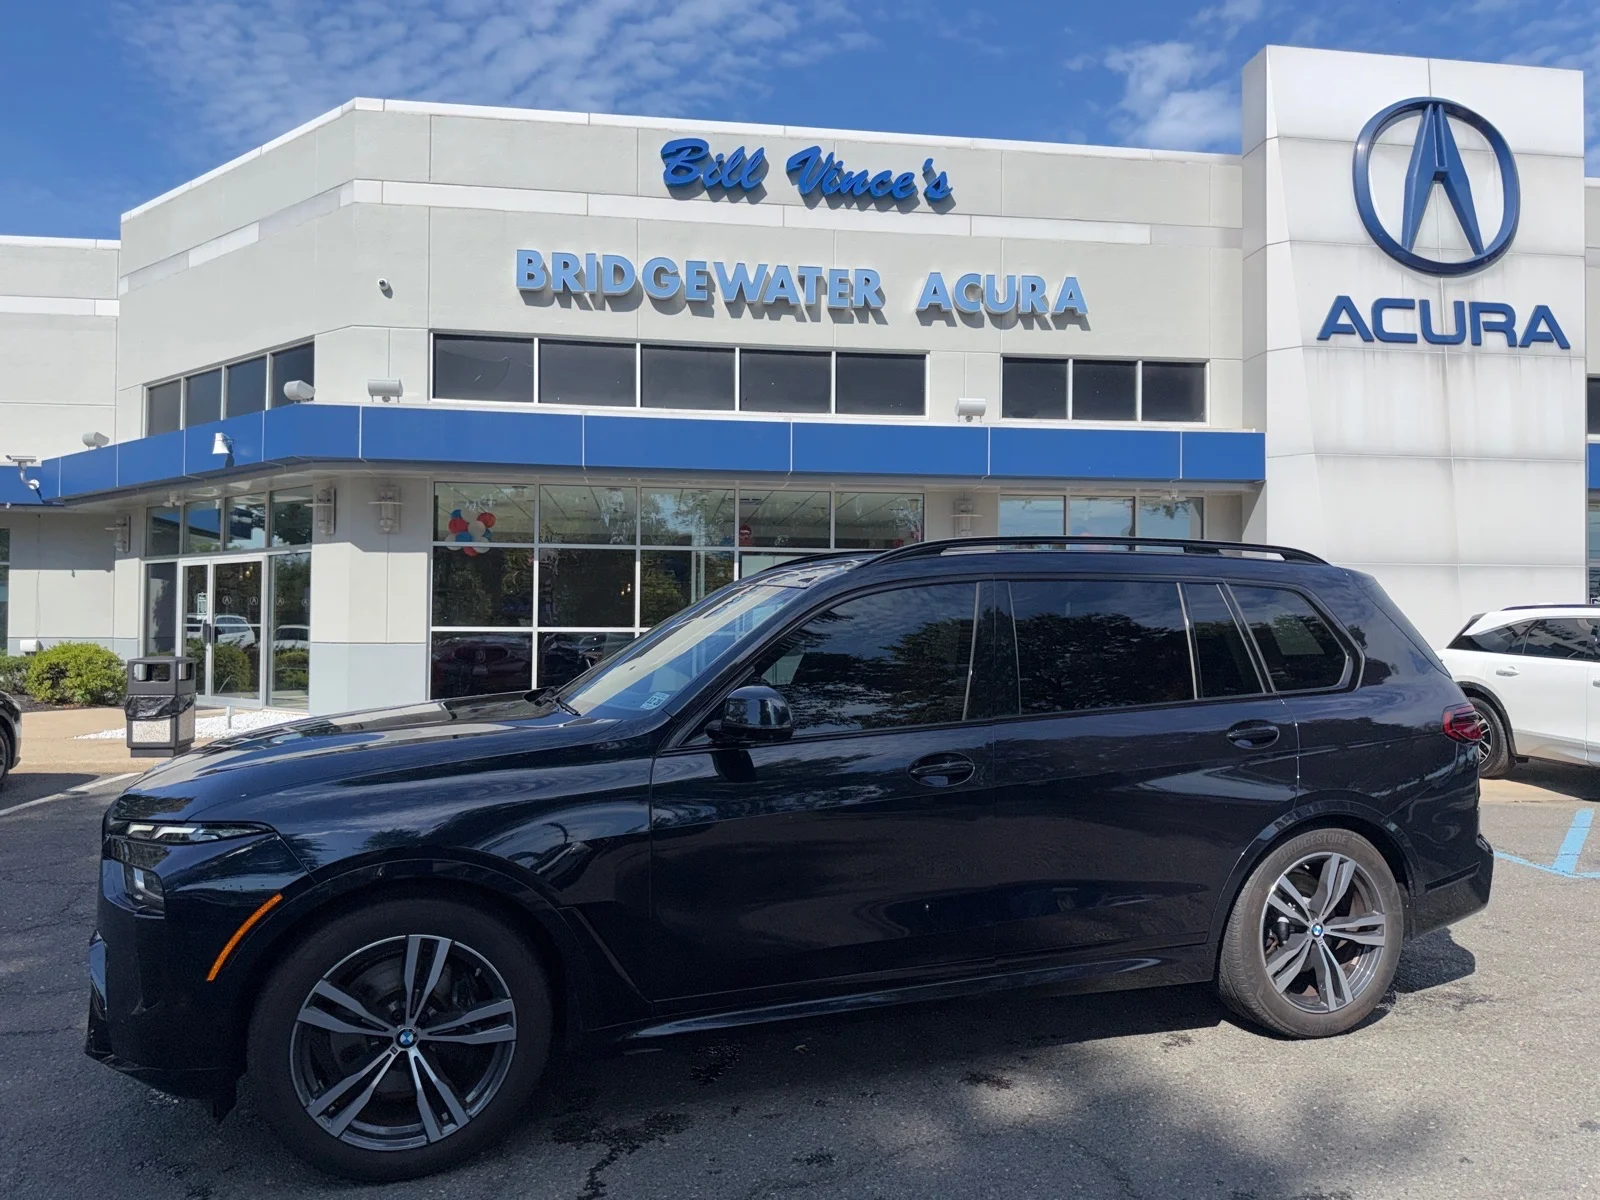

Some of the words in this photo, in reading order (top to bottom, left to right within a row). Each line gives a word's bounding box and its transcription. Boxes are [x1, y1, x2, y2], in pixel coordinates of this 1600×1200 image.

[661, 138, 765, 189] Bill
[786, 145, 954, 202] Vince's
[515, 248, 884, 311] BRIDGEWATER
[915, 271, 1090, 317] ACURA
[1316, 295, 1571, 350] ACURA
